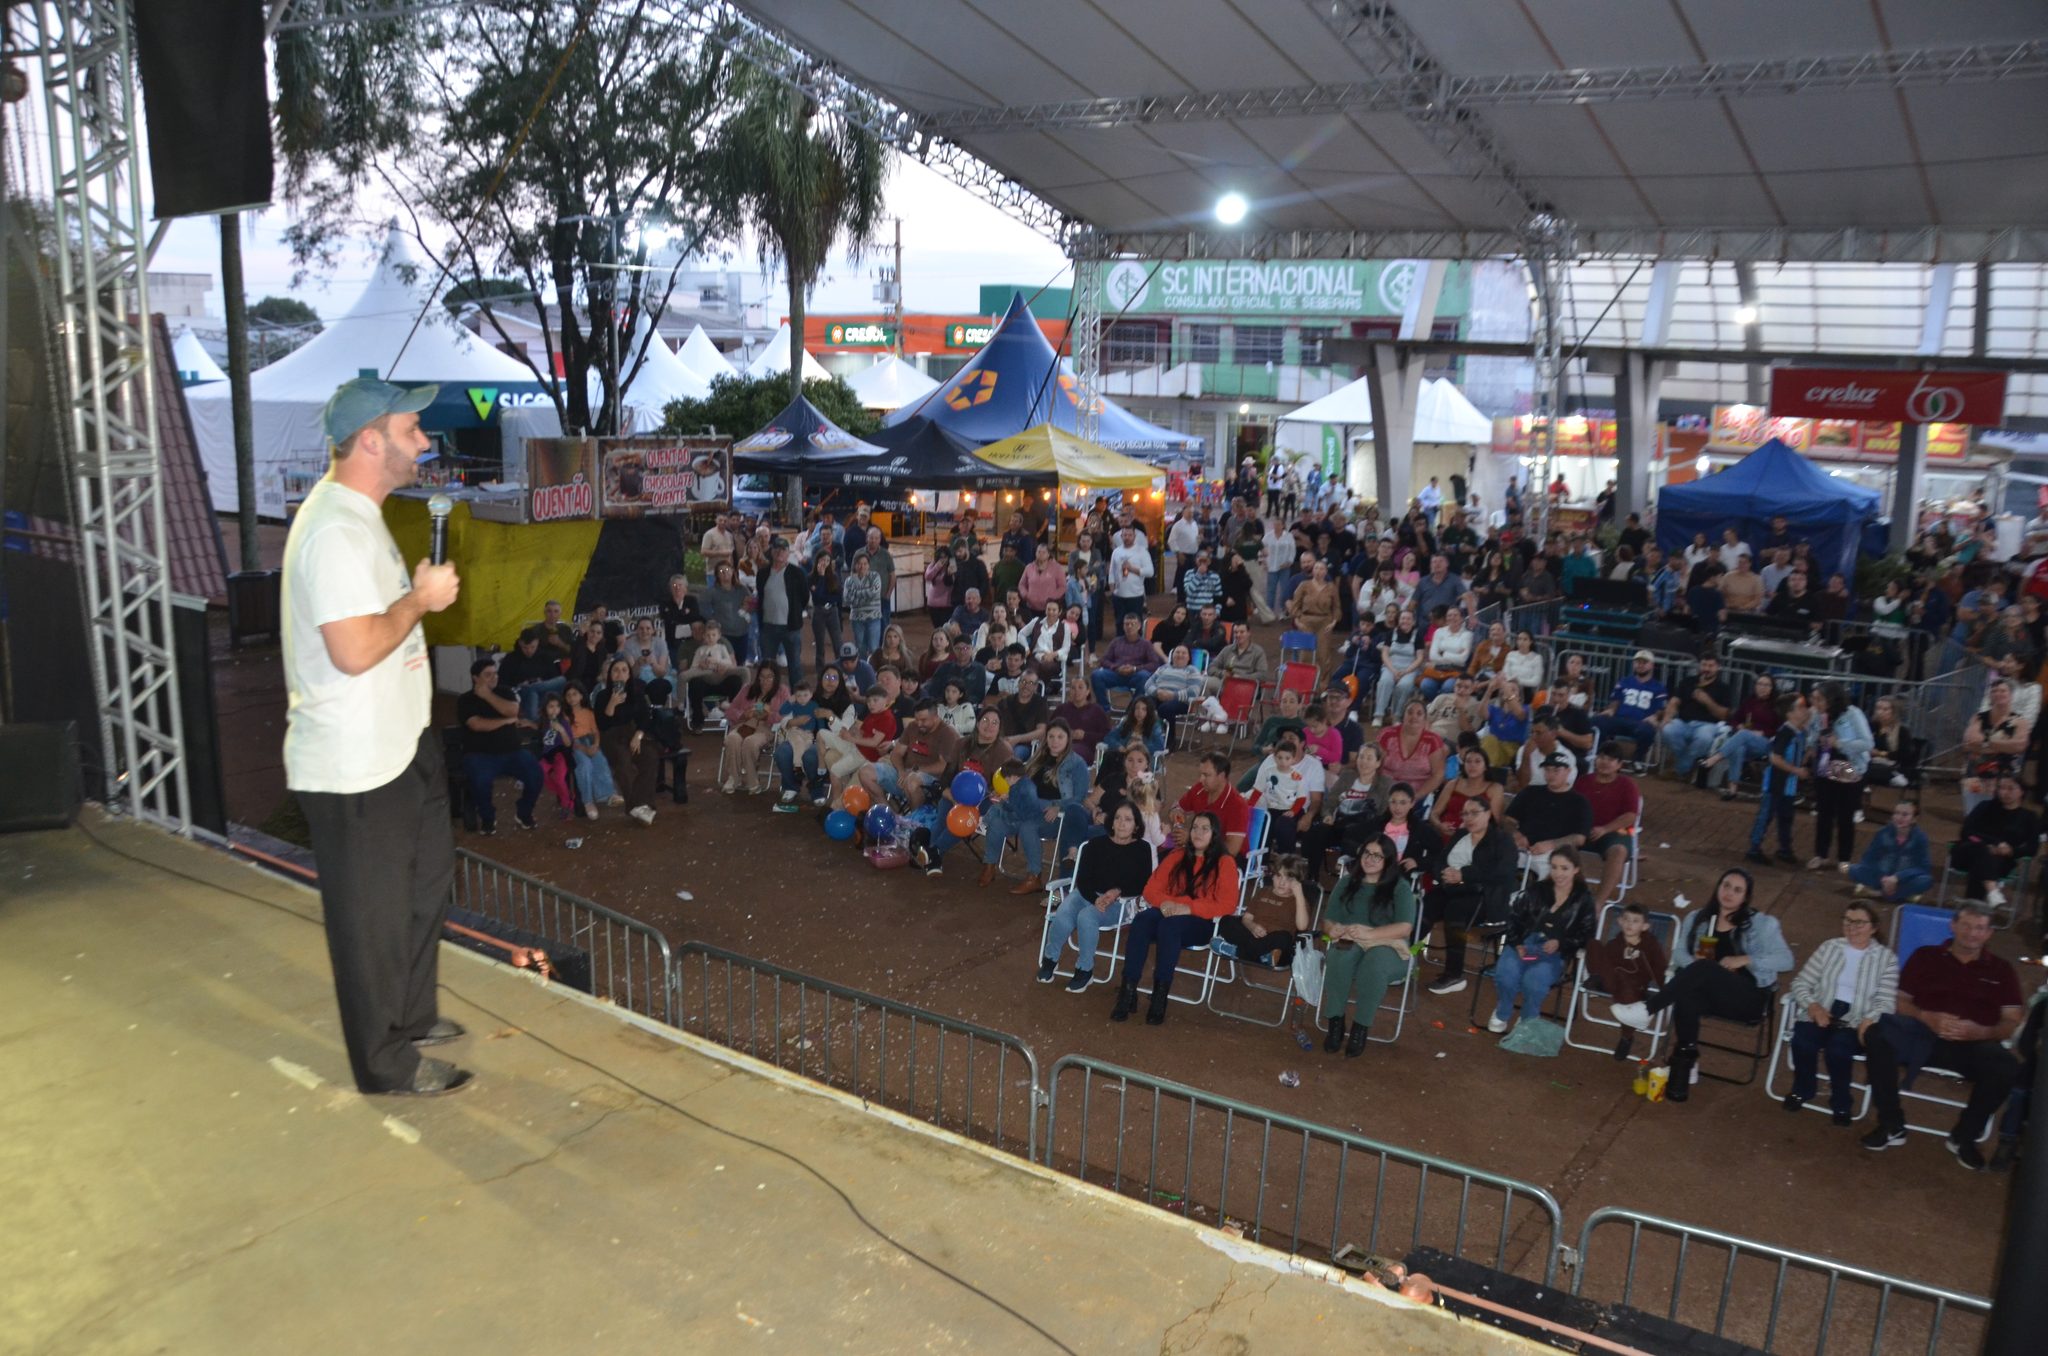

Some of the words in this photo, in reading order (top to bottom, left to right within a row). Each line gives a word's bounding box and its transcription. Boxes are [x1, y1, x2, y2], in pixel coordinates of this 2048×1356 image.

[1161, 266, 1188, 294] SC
[1193, 266, 1362, 296] INTERNACIONAL
[1164, 296, 1228, 308] CONSULADO
[1231, 296, 1275, 309] OFICIAL
[1279, 297, 1297, 309] DE
[845, 326, 887, 342] CRESOL
[1805, 381, 1881, 402] creluz
[642, 472, 693, 491] CHOCOLATE
[533, 473, 593, 522] QUENTÃO
[651, 490, 687, 507] QUENTE
